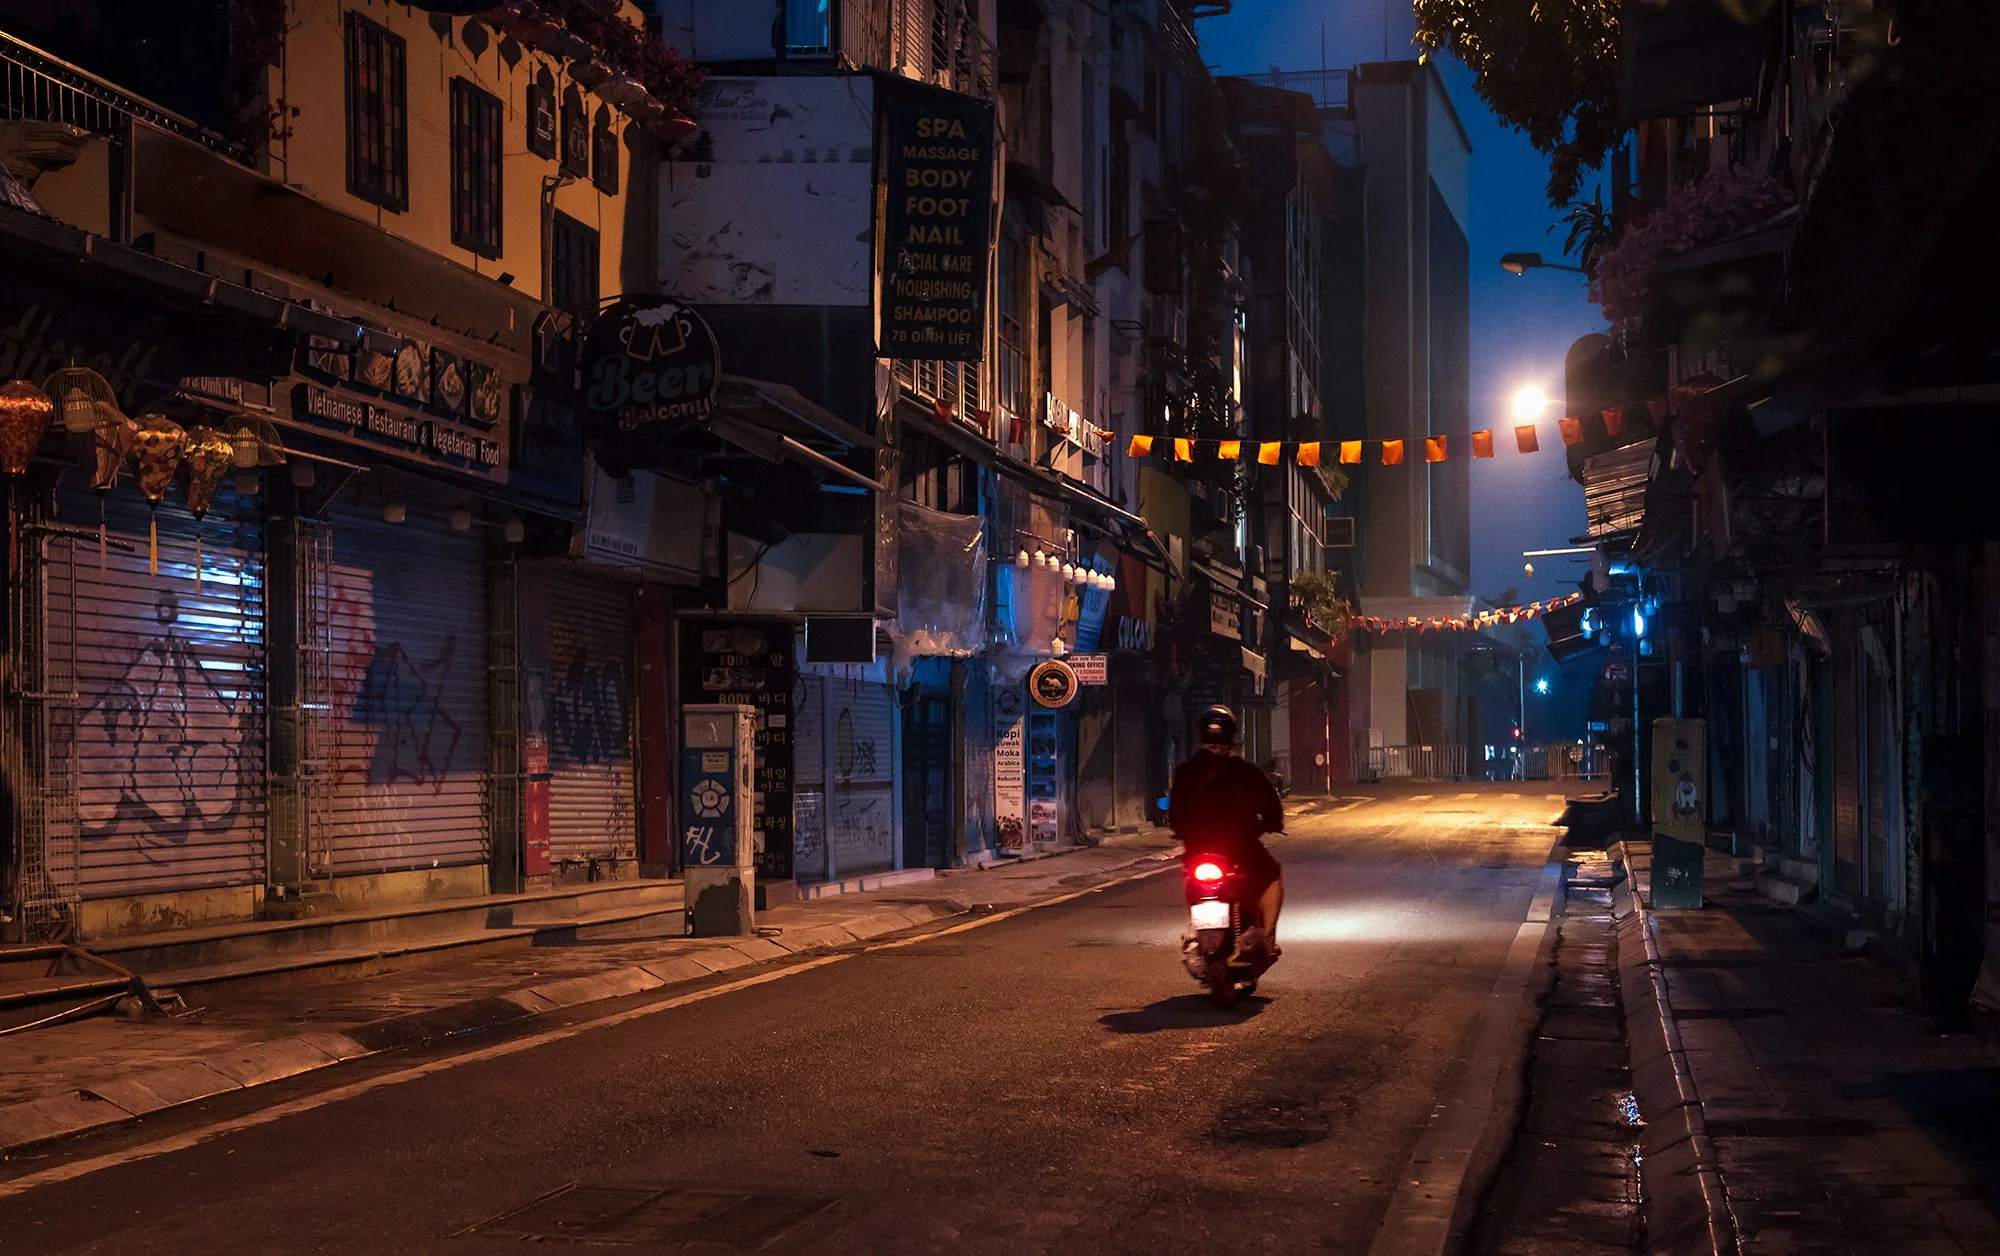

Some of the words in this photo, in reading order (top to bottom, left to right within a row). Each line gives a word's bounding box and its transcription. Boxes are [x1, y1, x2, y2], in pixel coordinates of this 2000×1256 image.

[915, 117, 968, 140] SPA
[902, 145, 980, 161] MASSAGE
[905, 168, 973, 189] BODY
[905, 196, 971, 217] FOOT
[907, 224, 964, 245] NAIL
[897, 250, 938, 272] FACIAL
[941, 253, 973, 273] CARE
[896, 279, 972, 300] NOURISHING
[894, 305, 972, 324] SHAMPOO
[586, 353, 713, 411] Beer
[618, 398, 710, 431] Balcony
[306, 386, 363, 425] Vietnamese
[367, 405, 418, 442] Restaurant
[420, 430, 427, 448] &
[432, 425, 476, 457] Vegetarian
[480, 440, 500, 465] Food
[718, 693, 752, 704] BODY
[996, 729, 1020, 740] Kopi
